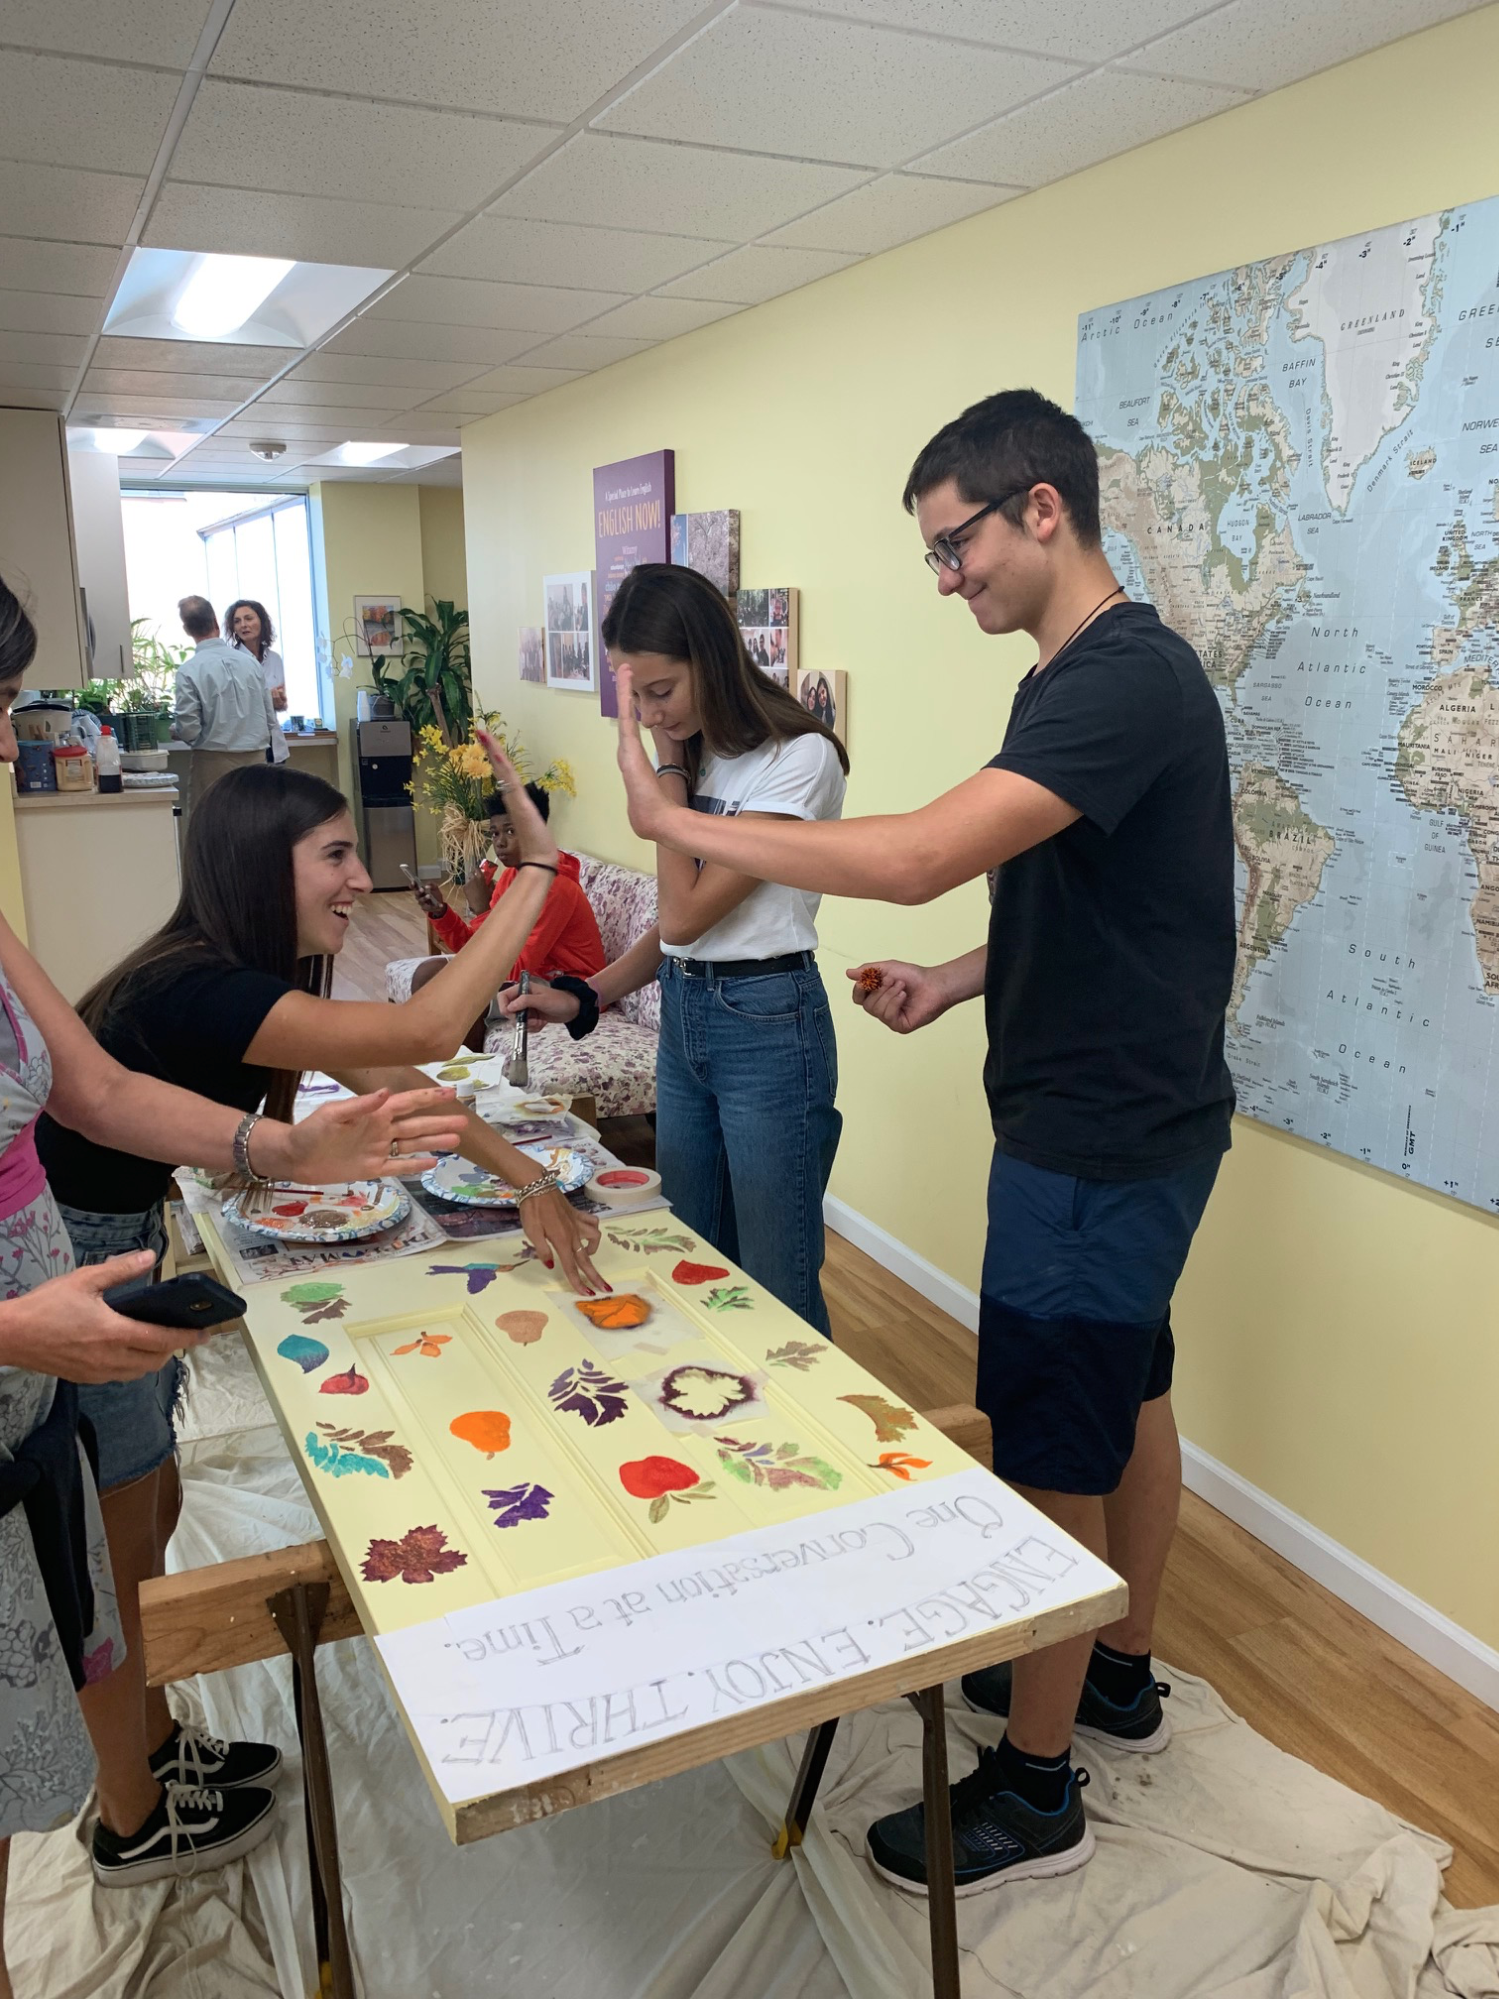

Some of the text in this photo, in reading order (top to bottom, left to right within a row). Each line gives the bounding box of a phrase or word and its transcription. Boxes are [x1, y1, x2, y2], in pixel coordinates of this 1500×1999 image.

[1458, 303, 1498, 322] GREE
[1340, 309, 1405, 331] GREENLAND
[1081, 312, 1173, 342] Arctic Ocean
[1282, 359, 1316, 372] BAFFIN
[1289, 378, 1307, 388] BAY
[1119, 396, 1150, 410] BEAUFORT
[1127, 418, 1139, 427] SEA
[1480, 443, 1498, 454] SEA
[1366, 429, 1414, 493] Denmark Strait
[1410, 458, 1437, 466] ICELAND
[598, 499, 661, 538] ENGLISH NOW!
[1298, 512, 1332, 521] LABRADOR
[1147, 522, 1205, 534] CANADA
[1311, 627, 1359, 638] North
[1198, 650, 1222, 658] TATES
[1297, 662, 1366, 674] Atlantic
[1304, 696, 1352, 709] Ocean
[1439, 704, 1476, 713] ALGERIA
[1429, 819, 1444, 827] GULF
[1269, 830, 1312, 844] BRAZIL
[1424, 843, 1446, 853] GUINEA
[1348, 943, 1416, 969] South
[1326, 989, 1430, 1027] Atlantic
[1339, 1043, 1406, 1074] Ocean
[1408, 1131, 1416, 1155] GMT
[444, 1494, 1004, 1667] One Conversation at a Time.
[440, 1535, 1080, 1766] ENGAGE. ENJOY. THRIVE.
